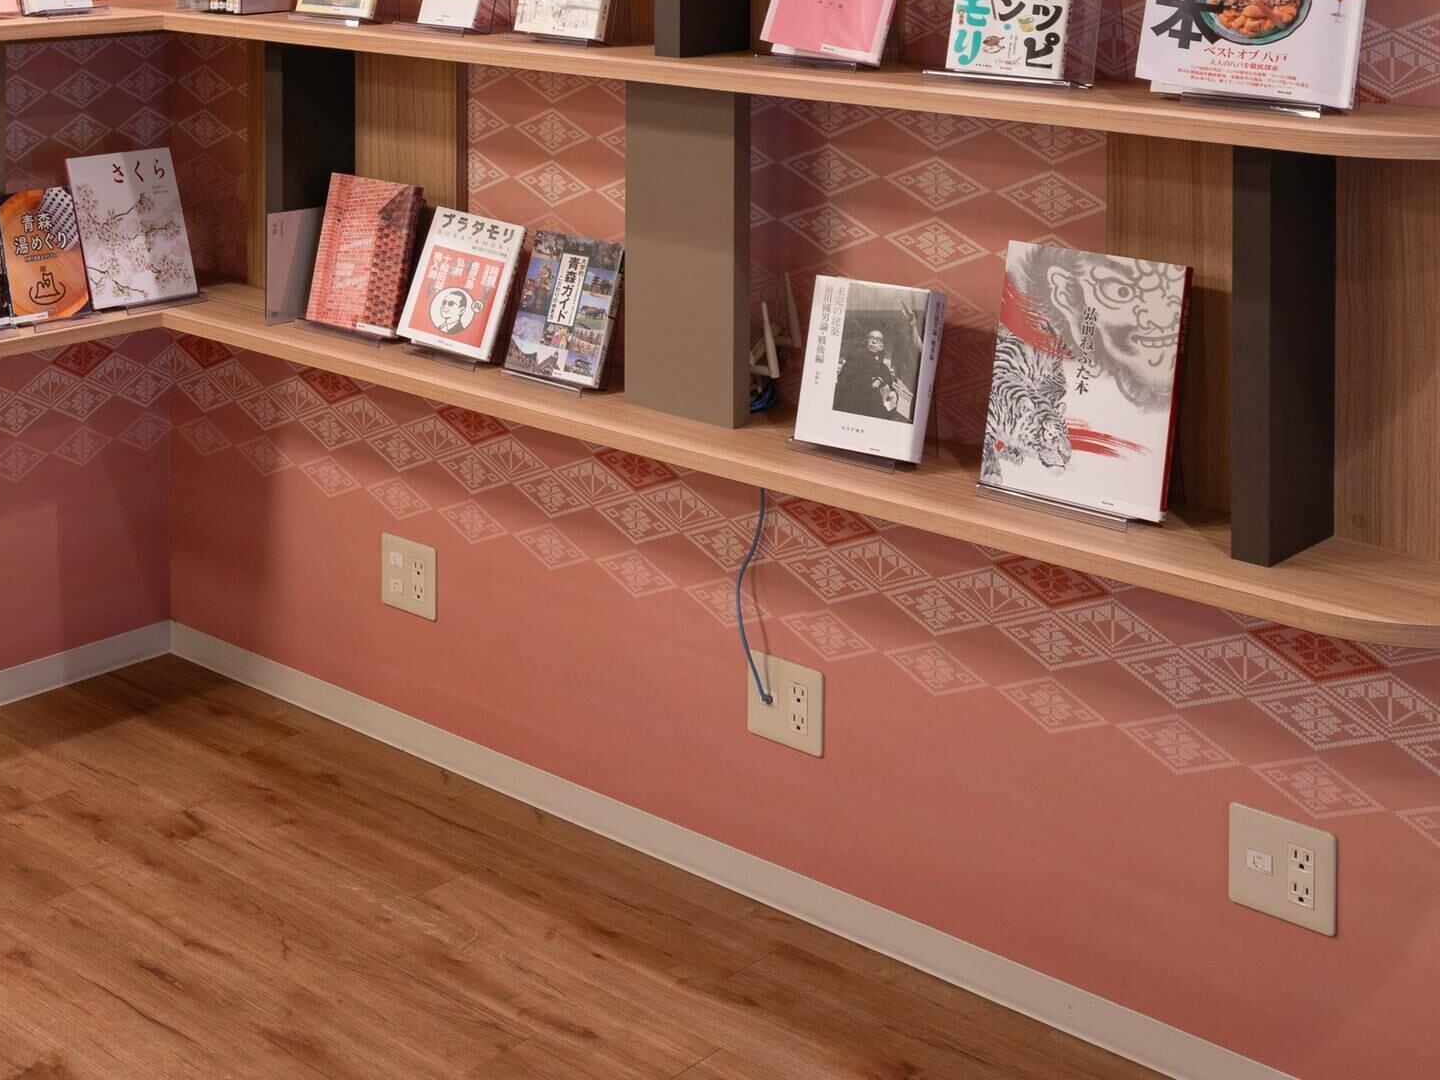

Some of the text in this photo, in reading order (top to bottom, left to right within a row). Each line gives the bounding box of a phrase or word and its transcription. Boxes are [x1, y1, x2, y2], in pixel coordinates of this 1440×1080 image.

[1204, 47, 1288, 62] ベスト オブ 八戸
[112, 158, 165, 183] さくら
[21, 212, 53, 233] 青森
[442, 213, 515, 243] ブラタモリ
[13, 232, 68, 256] 湯めぐり
[557, 256, 580, 322] 青森ガイド
